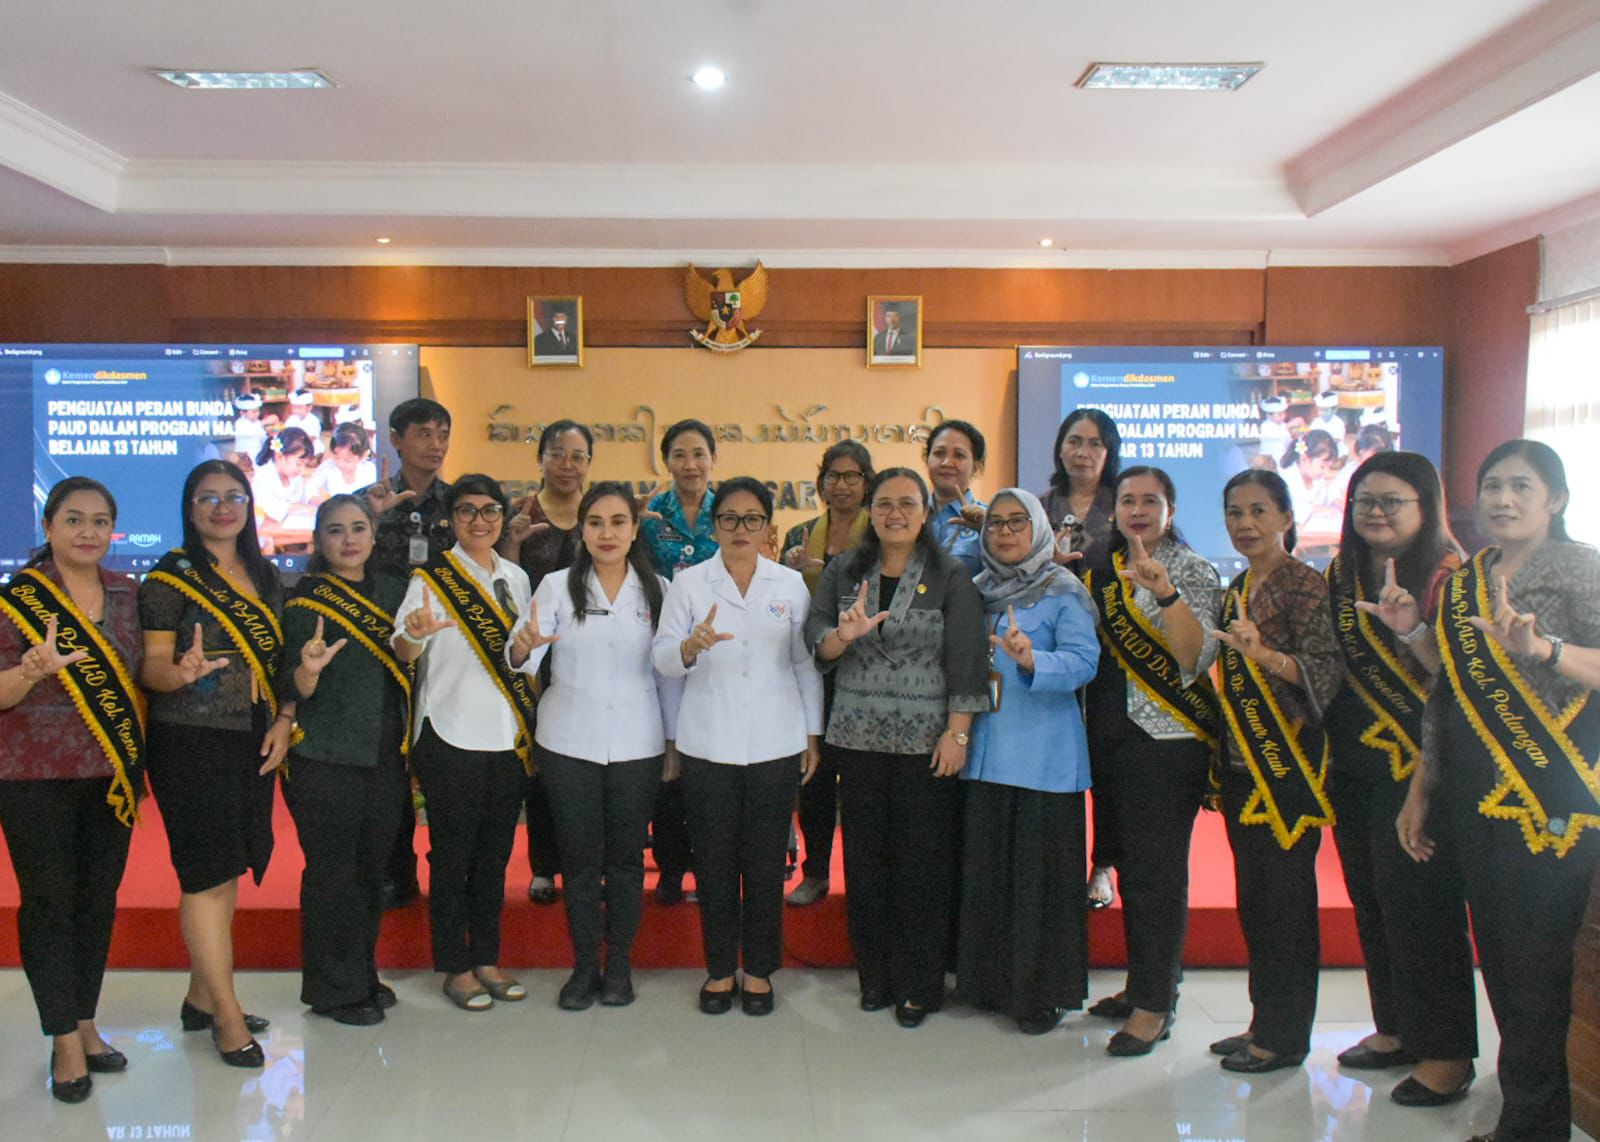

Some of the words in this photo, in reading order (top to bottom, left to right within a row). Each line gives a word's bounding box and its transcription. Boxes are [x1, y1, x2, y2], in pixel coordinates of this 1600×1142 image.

[62, 371, 147, 380] Kemendikdasmen
[1091, 374, 1175, 383] Kemendikdasmen
[48, 401, 133, 416] PENGUATAN
[135, 401, 183, 416] PERAN
[186, 401, 234, 416] BUNDA
[1162, 404, 1210, 419] PERAN
[1213, 404, 1260, 419] BUNDA
[48, 420, 87, 435] PAUD
[89, 420, 138, 435] DALAM
[140, 420, 210, 435] PROGRAM
[1167, 423, 1236, 438] PROGRAM
[48, 439, 111, 455] BELAJAR
[113, 440, 128, 455] 13
[131, 440, 177, 455] TAHUN
[1140, 442, 1155, 457] 13
[1157, 442, 1203, 458] TAHUN
[313, 583, 362, 618] Bunda
[1102, 580, 1119, 618] Bunda
[1451, 567, 1469, 604] Bunda
[229, 600, 275, 651] PAUD
[435, 566, 469, 606] Bunda
[465, 603, 504, 652] PAUD
[1110, 614, 1153, 660] PAUD
[1452, 603, 1478, 655] PAUD
[1147, 654, 1169, 682] Ds.
[1466, 656, 1489, 691] Kel.
[1240, 697, 1266, 739] Sanur
[1260, 736, 1291, 780] Kauh
[1487, 688, 1550, 770] Pedungan
